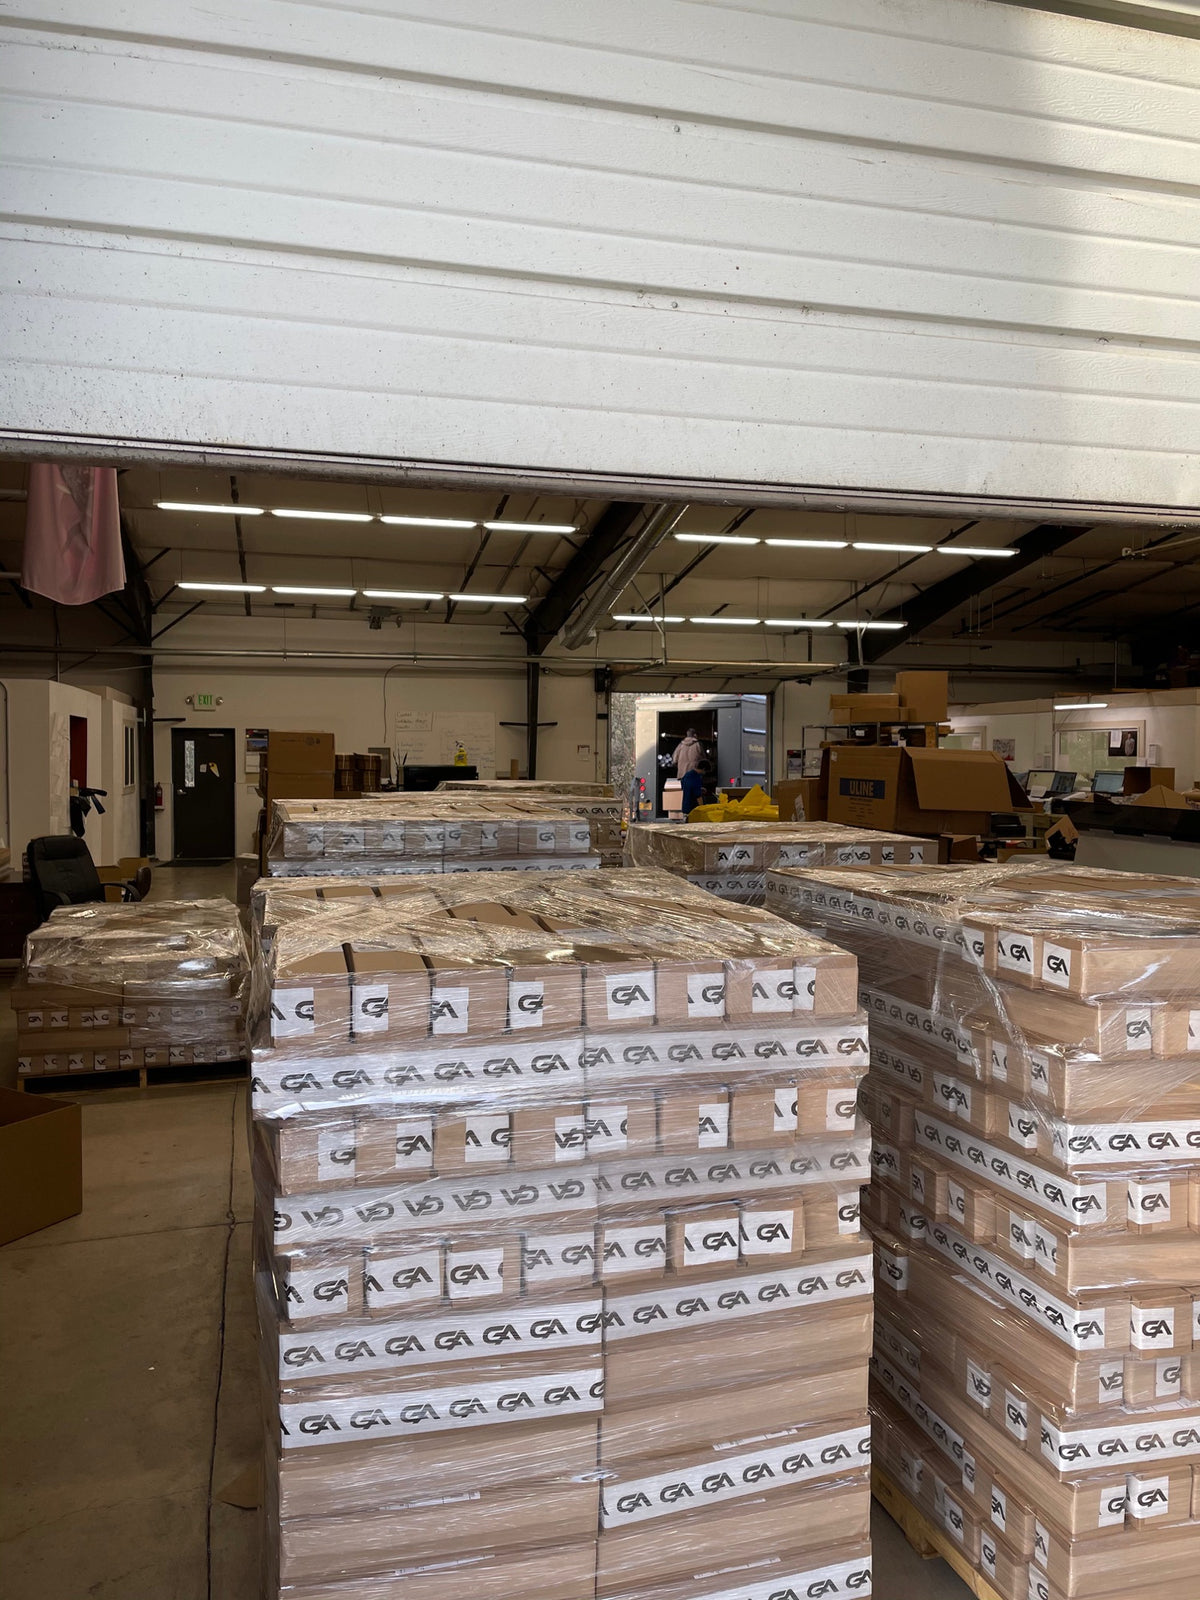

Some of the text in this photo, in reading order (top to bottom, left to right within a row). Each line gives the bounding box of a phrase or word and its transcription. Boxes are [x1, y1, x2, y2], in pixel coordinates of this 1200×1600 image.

[198, 695, 213, 705] EXIT
[849, 780, 874, 797] ULINE
[706, 880, 722, 889] GA
[727, 880, 743, 889] GA
[894, 916, 910, 931] GA
[913, 920, 930, 936] GA
[1010, 944, 1031, 962] GA
[1047, 955, 1069, 976] GA
[611, 984, 651, 1006] GA
[280, 1072, 324, 1094] GA
[332, 1068, 375, 1089] GA
[384, 1065, 425, 1086] GA
[433, 1062, 475, 1081] GA
[482, 1057, 523, 1078] GA
[530, 1054, 570, 1074] GA
[623, 1045, 660, 1064] GA
[667, 1043, 704, 1063] GA
[711, 1042, 747, 1061] GA
[754, 1040, 788, 1059] GA
[795, 1039, 829, 1057] GA
[837, 1037, 869, 1056] GA
[396, 1135, 432, 1156] GA
[1068, 1135, 1101, 1154] GA
[1108, 1133, 1141, 1152] GA
[1147, 1132, 1180, 1150] GA
[621, 1171, 657, 1191] GA
[665, 1168, 700, 1187] GA
[708, 1164, 741, 1183] GA
[749, 1161, 783, 1179] GA
[790, 1156, 822, 1175] GA
[830, 1152, 862, 1171] GA
[924, 1125, 1102, 1214] GA GA GA GA GA GA GA
[1141, 1193, 1169, 1212] GA
[702, 1231, 737, 1251] GA
[756, 1222, 790, 1242] GA
[1011, 1222, 1031, 1247] GA
[561, 1244, 594, 1265] GA
[392, 1266, 433, 1290] GA
[450, 1263, 489, 1285] GA
[933, 1229, 951, 1249] GA
[952, 1241, 971, 1264] GA
[973, 1256, 992, 1279] GA
[995, 1271, 1015, 1296] GA
[1044, 1305, 1068, 1332] GA
[1073, 1321, 1104, 1339] GA
[633, 1269, 866, 1324] GA GA GA GA GA GA
[1142, 1320, 1172, 1338] GA
[283, 1345, 326, 1367] GA
[335, 1340, 376, 1361] GA
[385, 1335, 426, 1356] GA
[434, 1329, 474, 1350] GA
[482, 1324, 522, 1345] GA
[530, 1318, 568, 1339] GA
[299, 1386, 581, 1435] GA GA GA GA GA GA
[1007, 1403, 1027, 1428] GA
[1058, 1429, 1200, 1461] GA GA GA GA
[616, 1492, 652, 1513] GA
[660, 1482, 694, 1503] GA
[701, 1472, 735, 1493] GA
[742, 1462, 775, 1483] GA
[782, 1453, 814, 1473] GA
[820, 1444, 851, 1464] GA
[1137, 1488, 1168, 1507] GA
[807, 1579, 839, 1599] GA
[846, 1569, 871, 1589] GA
